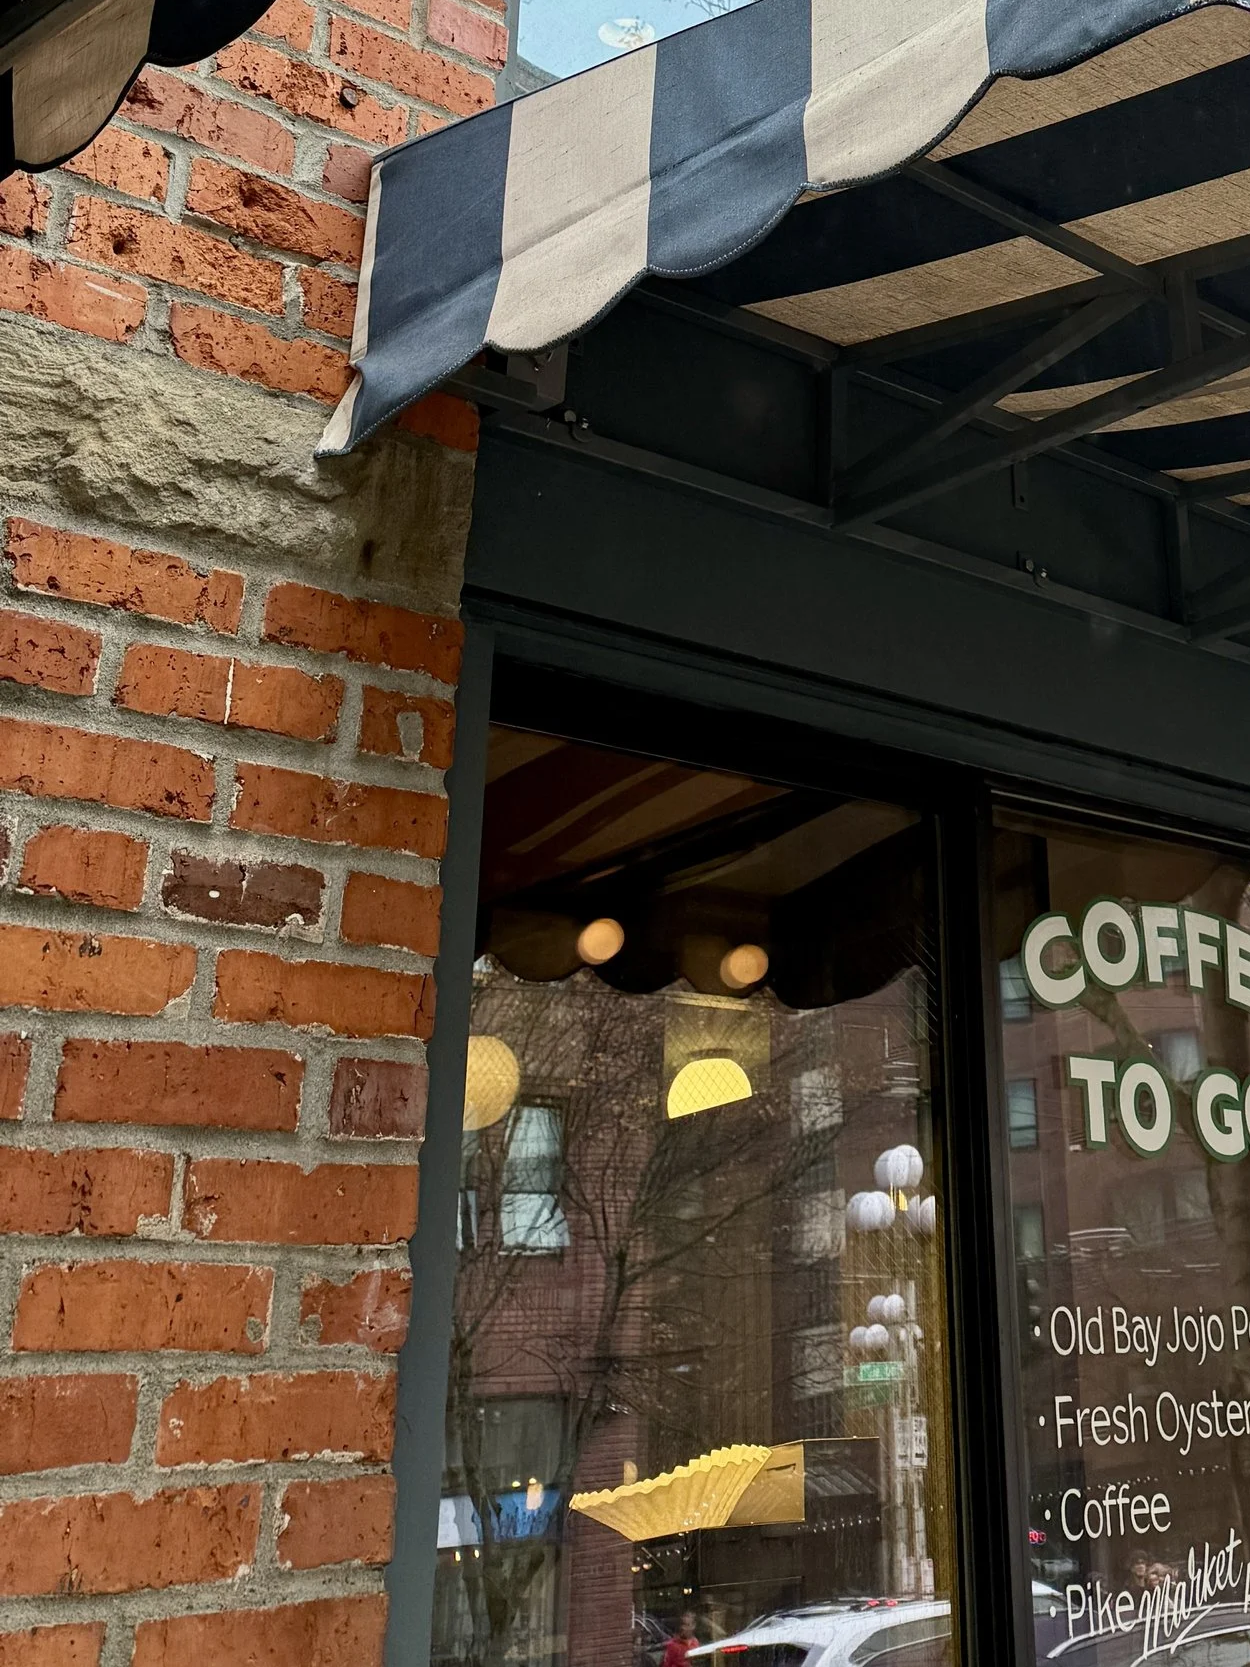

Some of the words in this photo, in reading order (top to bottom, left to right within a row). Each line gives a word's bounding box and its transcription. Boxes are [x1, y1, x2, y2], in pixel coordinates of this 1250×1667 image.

[1069, 1056, 1172, 1152] TO
[1050, 1305, 1105, 1356] Old
[1111, 1306, 1162, 1367] Bay
[1166, 1305, 1225, 1366] Jojo
[1054, 1392, 1149, 1449] Fresh
[1060, 1483, 1172, 1542] Coffee
[1066, 1580, 1136, 1639] Pike
